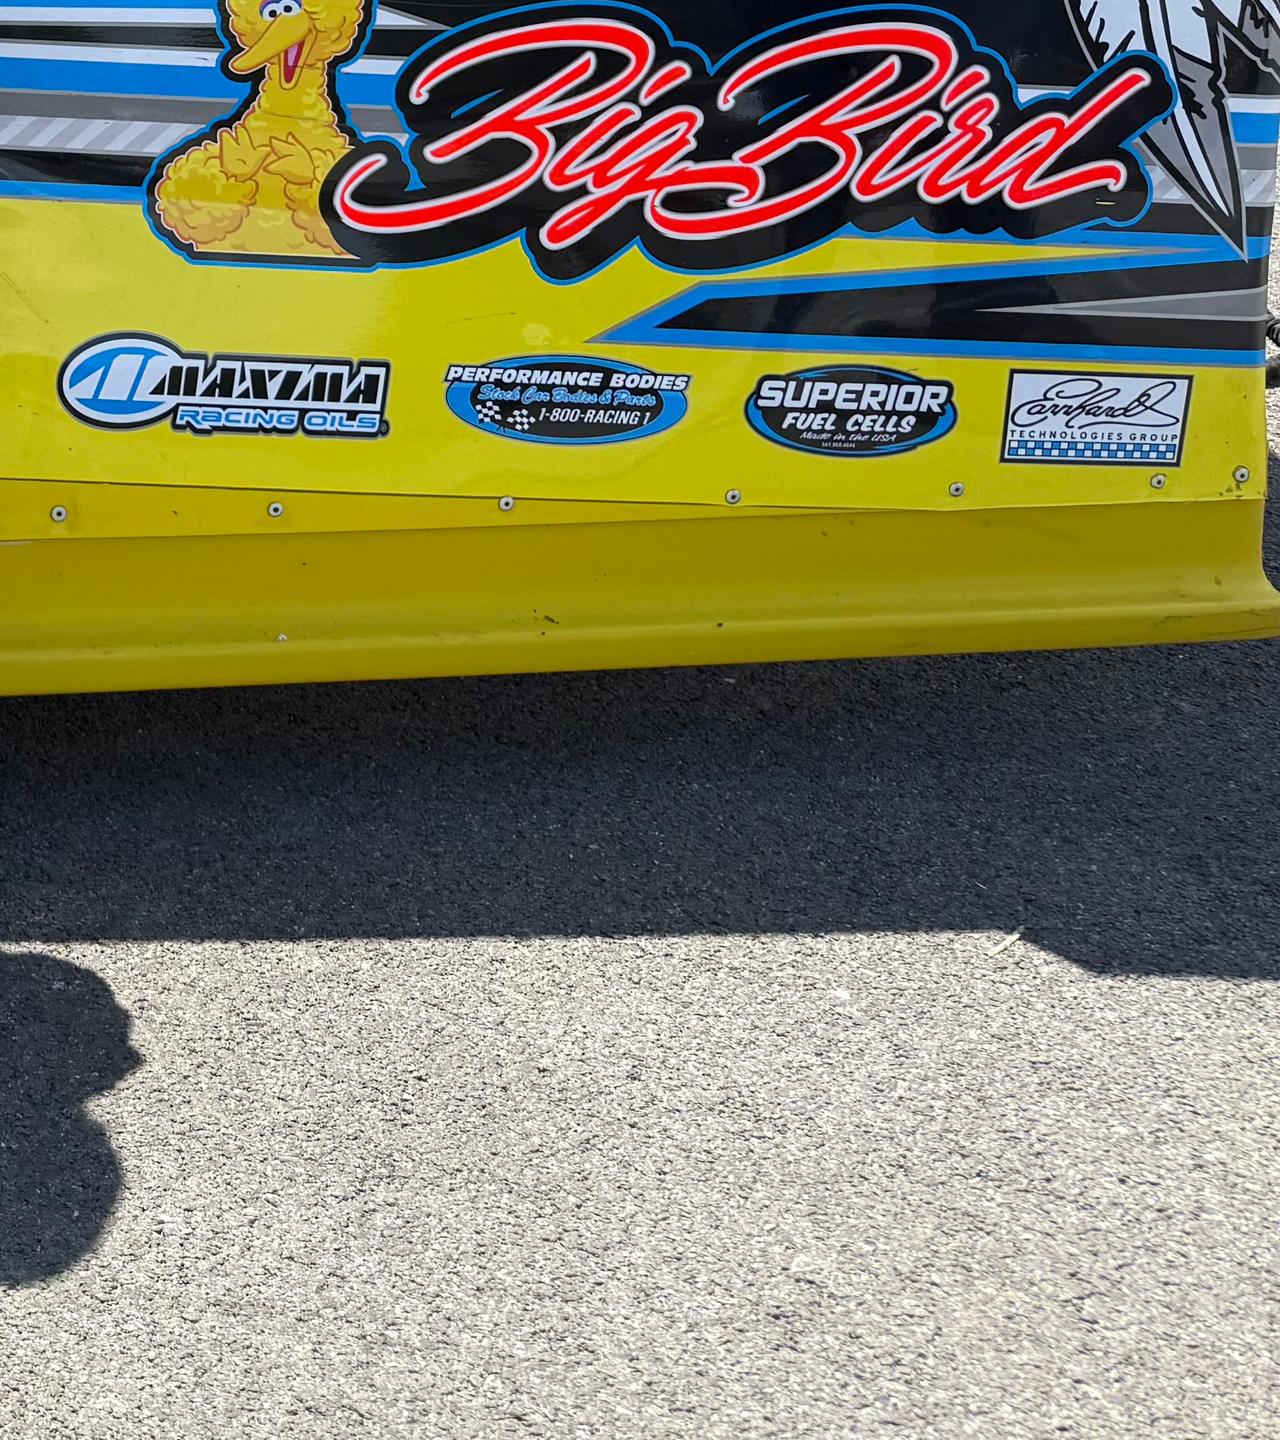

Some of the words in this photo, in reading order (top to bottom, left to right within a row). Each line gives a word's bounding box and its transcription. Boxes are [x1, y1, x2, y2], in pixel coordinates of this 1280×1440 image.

[338, 17, 704, 252] Big
[645, 19, 1151, 241] Bird
[147, 362, 388, 405] MAXIMA
[446, 365, 604, 388] PERFORMANCE
[609, 373, 690, 391] BODIES
[477, 383, 521, 402] Stock
[520, 386, 551, 405] Car
[552, 387, 599, 405] Bodies
[599, 391, 612, 405] &
[612, 391, 657, 408] Parts
[756, 379, 950, 413] SUPERIOR
[178, 408, 297, 430] RACING
[303, 412, 381, 433] OILS
[538, 406, 640, 425] 1-800-RACING
[642, 411, 652, 425] 1
[781, 411, 837, 431] FUEL
[845, 413, 918, 433] CELLS
[800, 430, 832, 441] Made
[833, 432, 846, 441] in
[848, 432, 868, 442] the
[870, 433, 899, 442] USA
[1009, 429, 1124, 441] TECHNOLOGIES
[1129, 432, 1178, 442] GROUP
